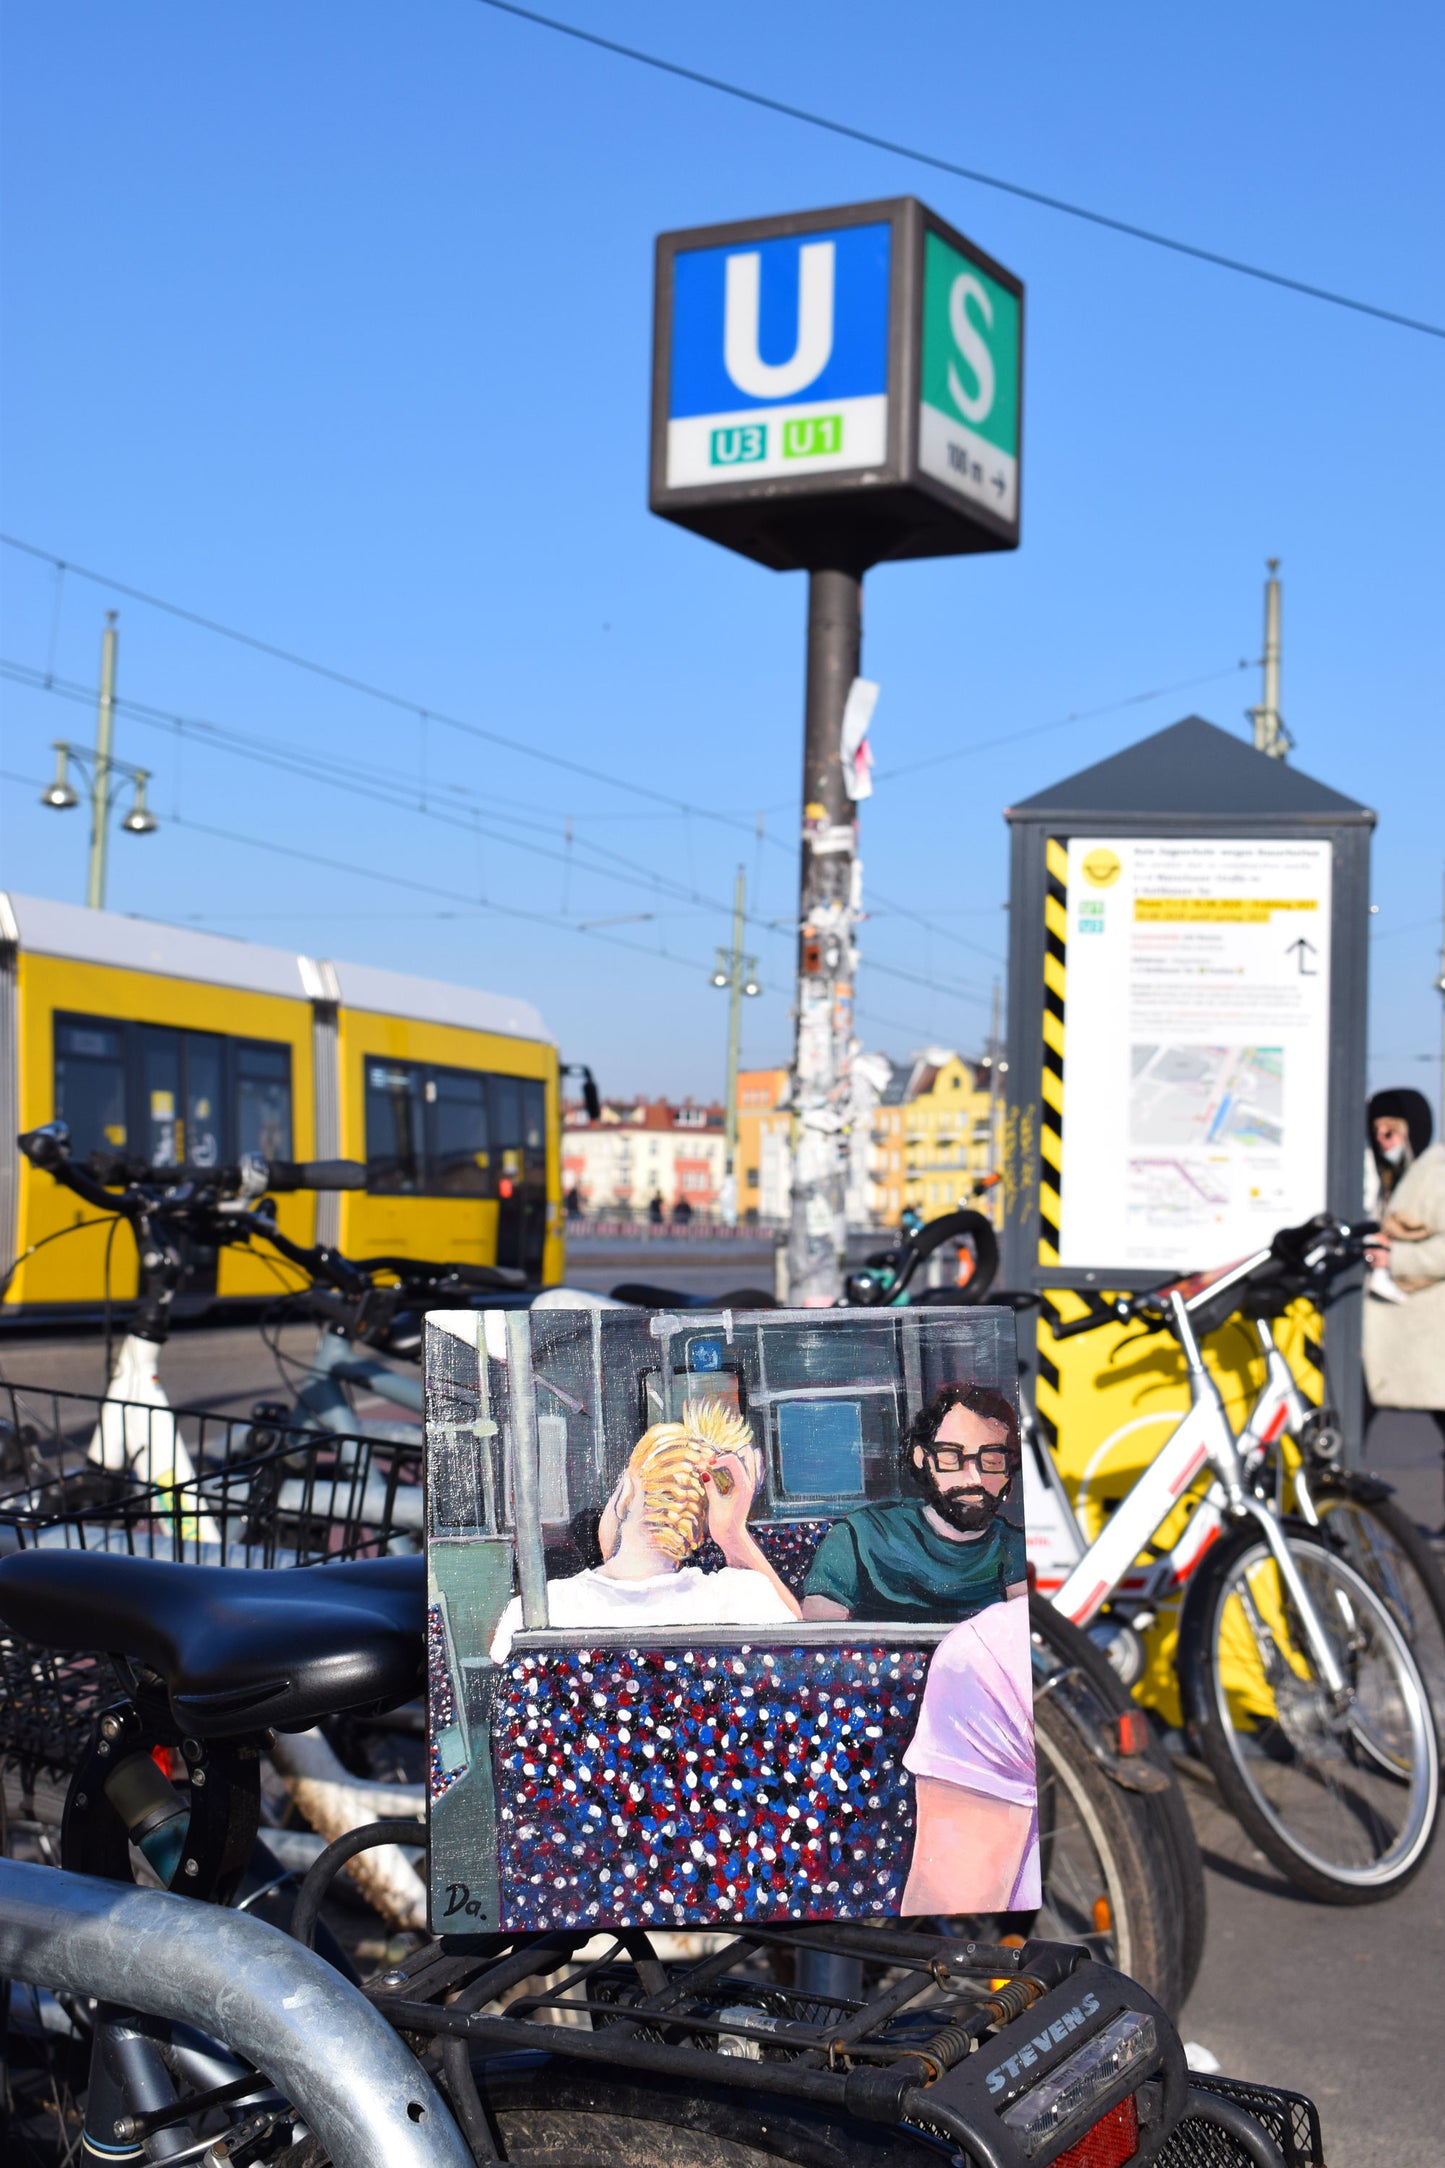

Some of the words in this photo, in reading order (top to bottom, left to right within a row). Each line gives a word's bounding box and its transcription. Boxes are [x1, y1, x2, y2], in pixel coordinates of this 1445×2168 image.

[723, 240, 836, 399] U
[947, 272, 997, 425] S
[715, 427, 764, 462] U3
[788, 419, 834, 456] U1
[985, 1992, 1101, 2095] STEVENS
